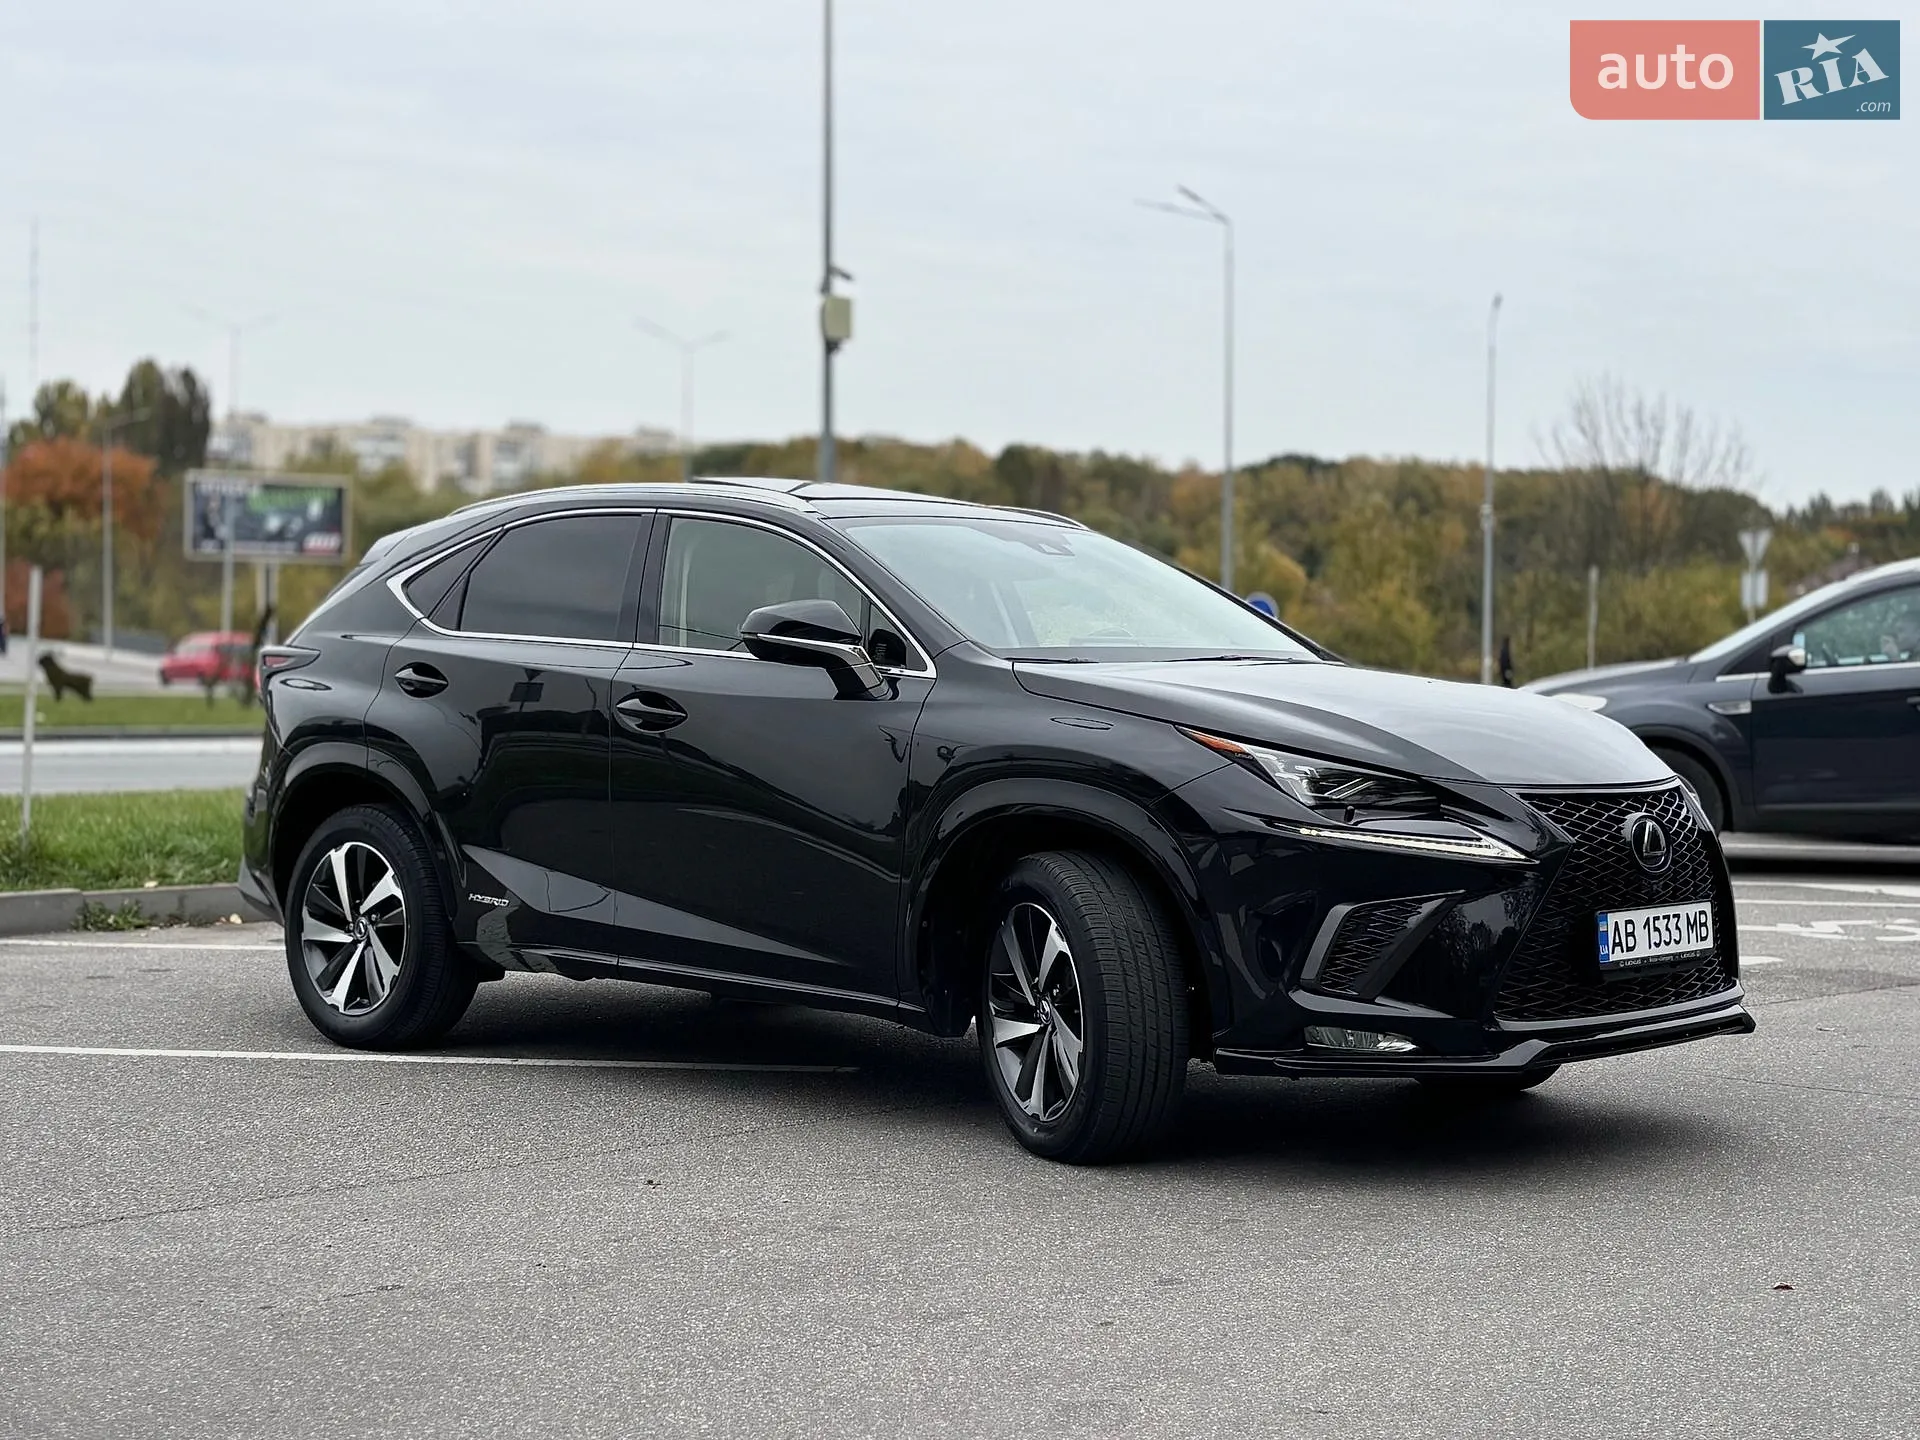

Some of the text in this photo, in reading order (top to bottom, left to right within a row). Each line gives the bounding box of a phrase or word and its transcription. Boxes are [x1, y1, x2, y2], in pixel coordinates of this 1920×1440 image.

[468, 893, 509, 906] HYBRID
[1612, 910, 1709, 954] AB 1533 MB
